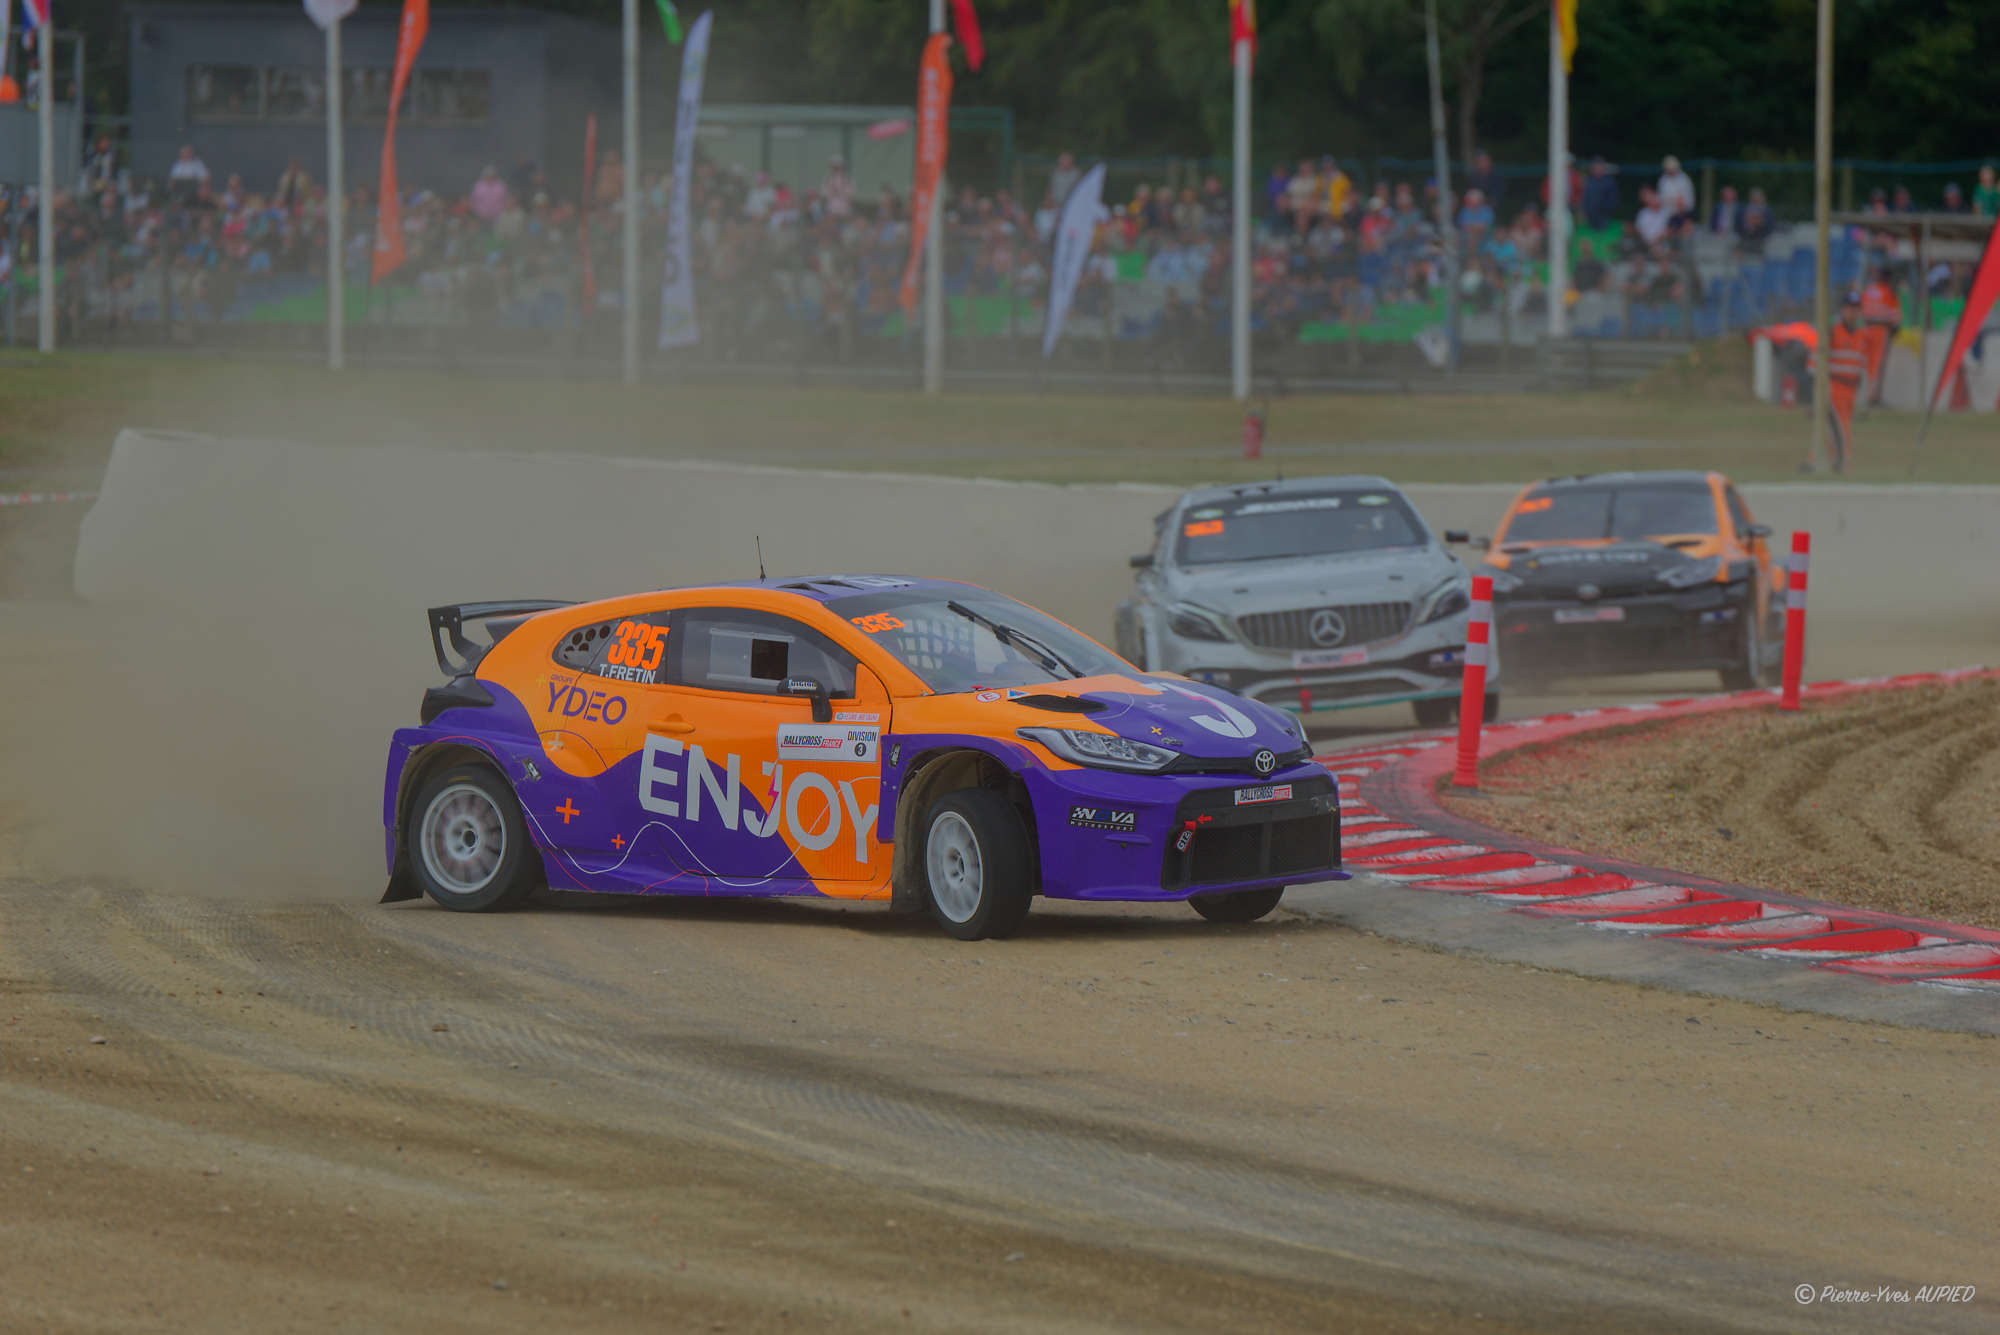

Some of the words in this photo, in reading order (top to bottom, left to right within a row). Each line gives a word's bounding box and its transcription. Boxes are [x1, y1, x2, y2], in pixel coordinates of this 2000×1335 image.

[850, 612, 905, 633] 335
[607, 620, 671, 671] 335
[599, 663, 657, 684] T.FRETIN
[547, 681, 628, 725] YDEO
[783, 735, 823, 746] RALLYCROSS
[822, 739, 843, 749] FRANCE
[847, 731, 877, 742] DIVISION
[638, 733, 879, 865] ENJOY
[1239, 785, 1274, 802] RALLYCROSS
